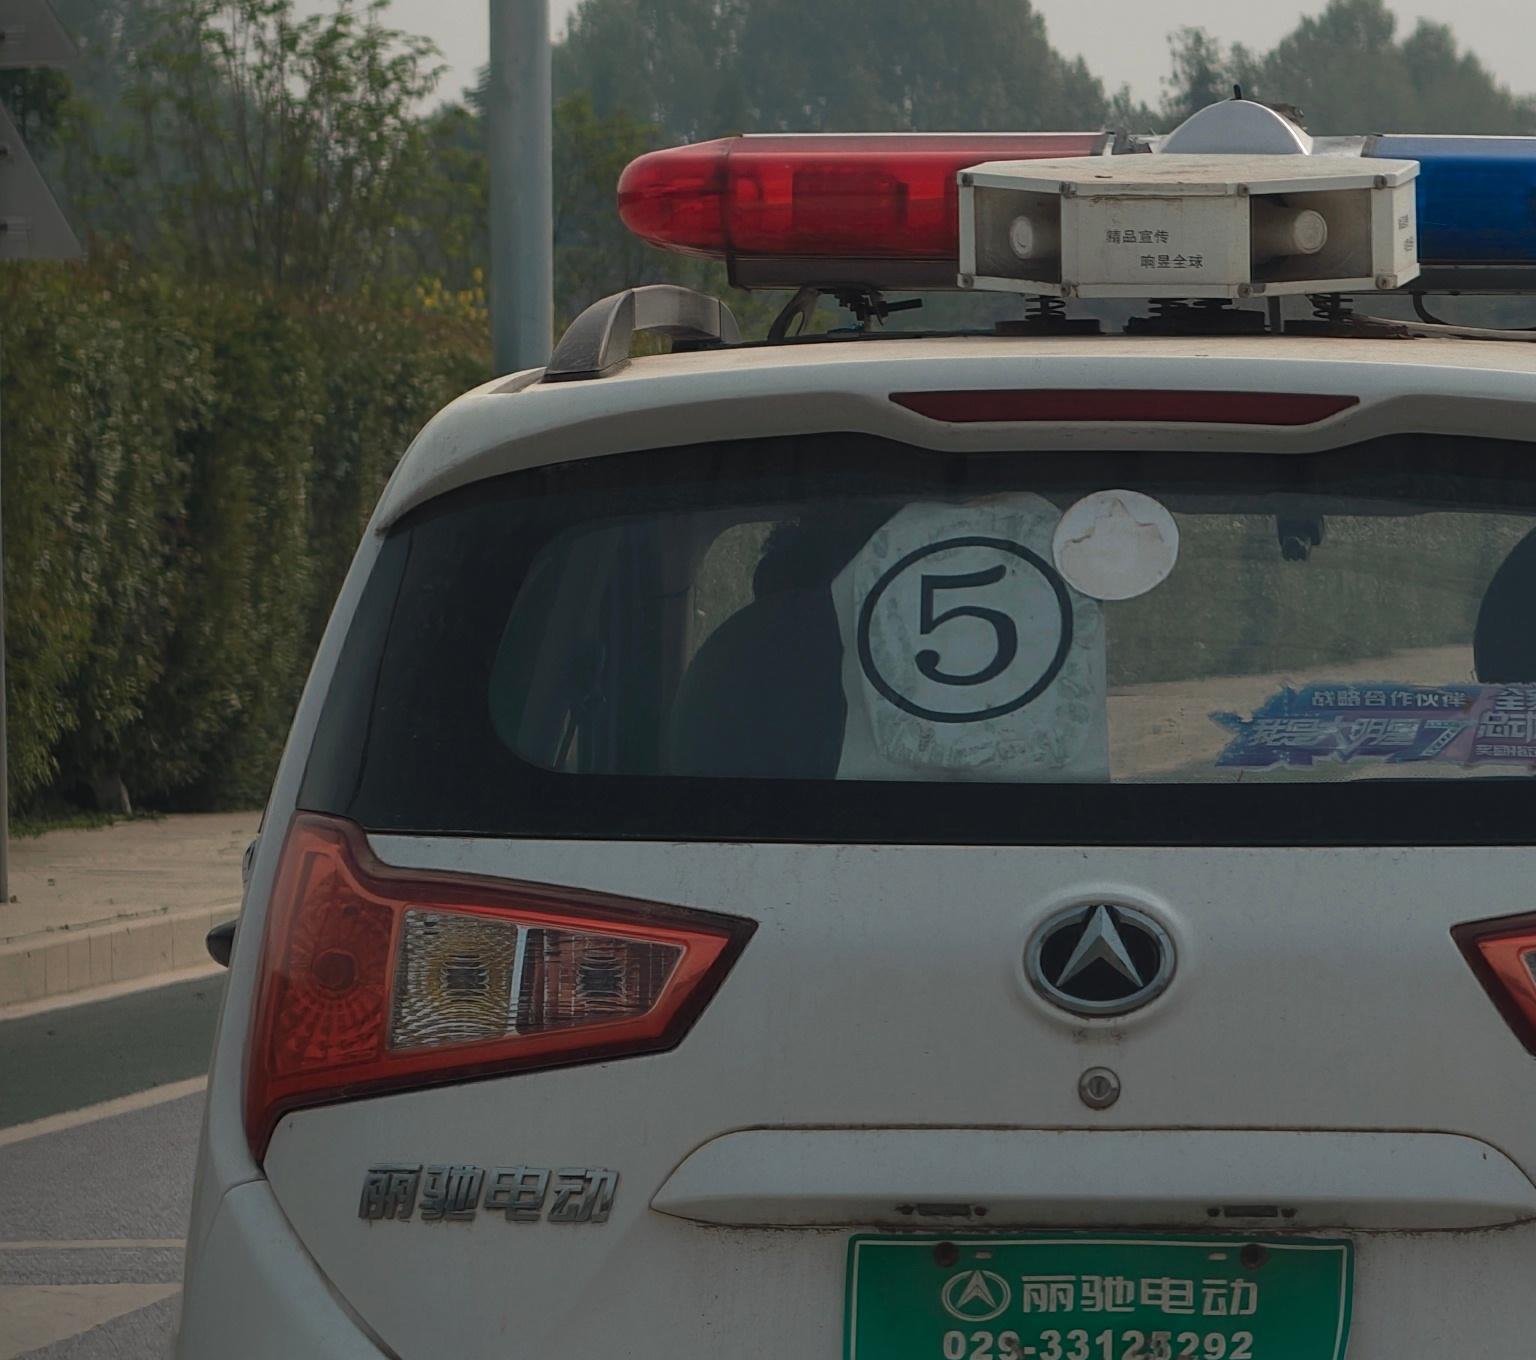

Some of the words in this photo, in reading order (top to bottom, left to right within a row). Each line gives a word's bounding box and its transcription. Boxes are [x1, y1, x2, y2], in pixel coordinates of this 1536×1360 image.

[915, 564, 1018, 686] 5
[1311, 688, 1467, 708] 战略合作伙伴
[358, 1163, 620, 1223] 丽驰电动
[1021, 1274, 1259, 1317] 丽驰电动
